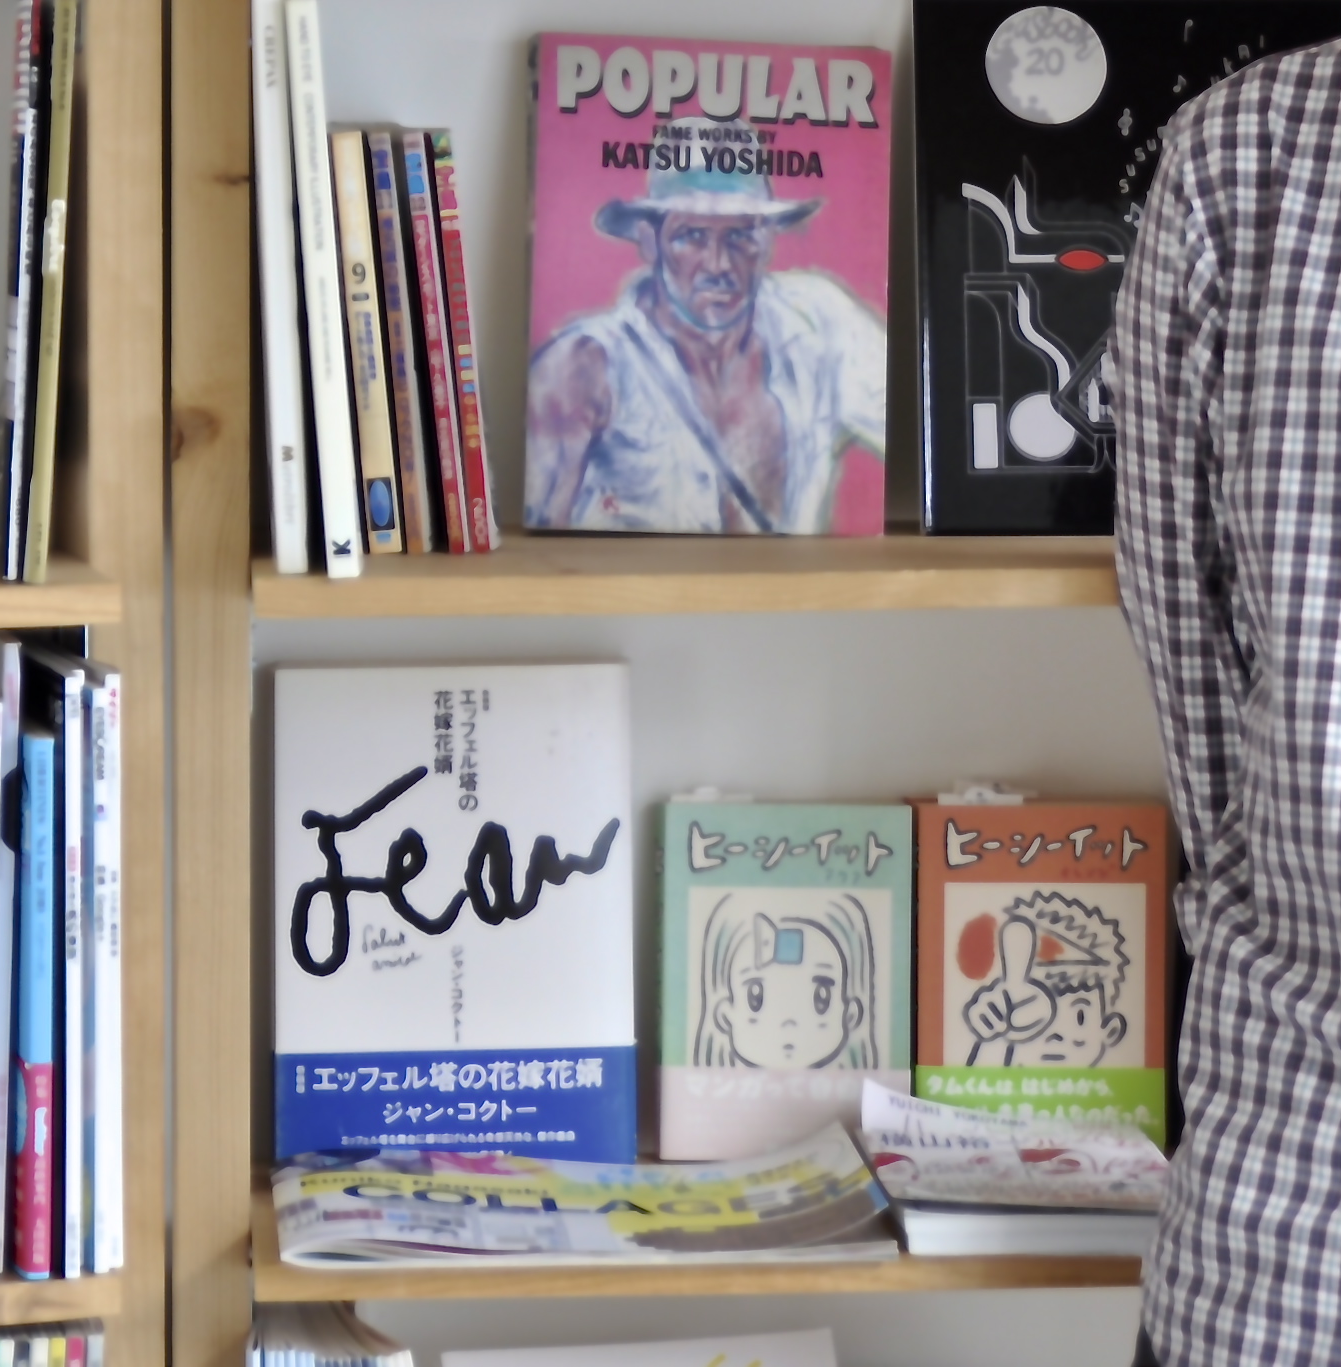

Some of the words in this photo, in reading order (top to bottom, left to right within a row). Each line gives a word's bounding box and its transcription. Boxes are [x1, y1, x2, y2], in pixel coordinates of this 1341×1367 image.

[1025, 47, 1067, 78] 20
[556, 44, 880, 129] POPULAR
[651, 125, 698, 144] FAME
[698, 126, 754, 145] WORKS
[755, 128, 778, 146] BY
[601, 141, 694, 173] KATSU
[700, 145, 825, 179] YOSHIDA
[458, 689, 479, 813] エッフェル塔の
[312, 1058, 604, 1094] エッフェル塔の花嫁花婿
[382, 1101, 538, 1125] ジャン・コクトー
